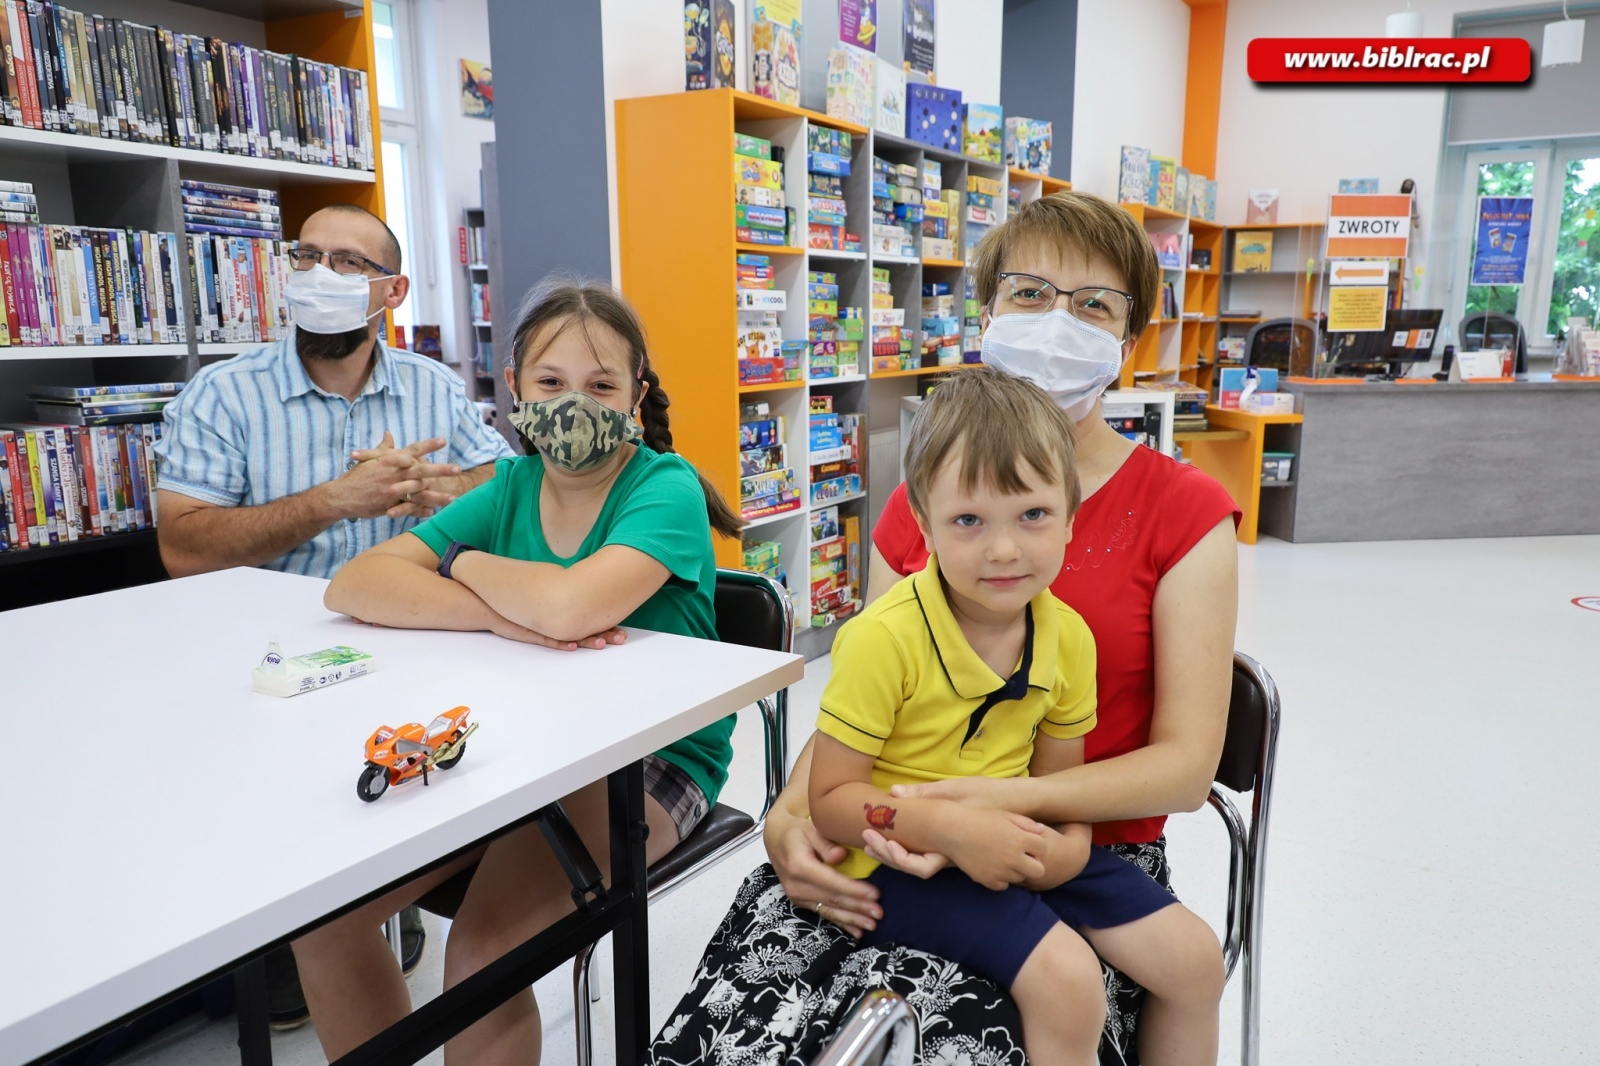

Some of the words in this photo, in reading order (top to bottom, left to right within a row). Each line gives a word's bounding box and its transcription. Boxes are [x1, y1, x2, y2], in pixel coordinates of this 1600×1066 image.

[6, 45, 15, 76] eragon
[331, 85, 336, 97] RV
[1339, 221, 1400, 234] ZWROTY
[88, 271, 98, 306] MUSTANG
[107, 277, 115, 300] SCHOOL
[158, 294, 164, 304] OD
[763, 296, 784, 304] ICECOOL
[874, 344, 899, 355] REBUSY
[59, 448, 68, 472] Marley
[50, 458, 59, 482] SZANSA
[62, 479, 71, 487] Ja
[53, 483, 62, 501] EMMY
